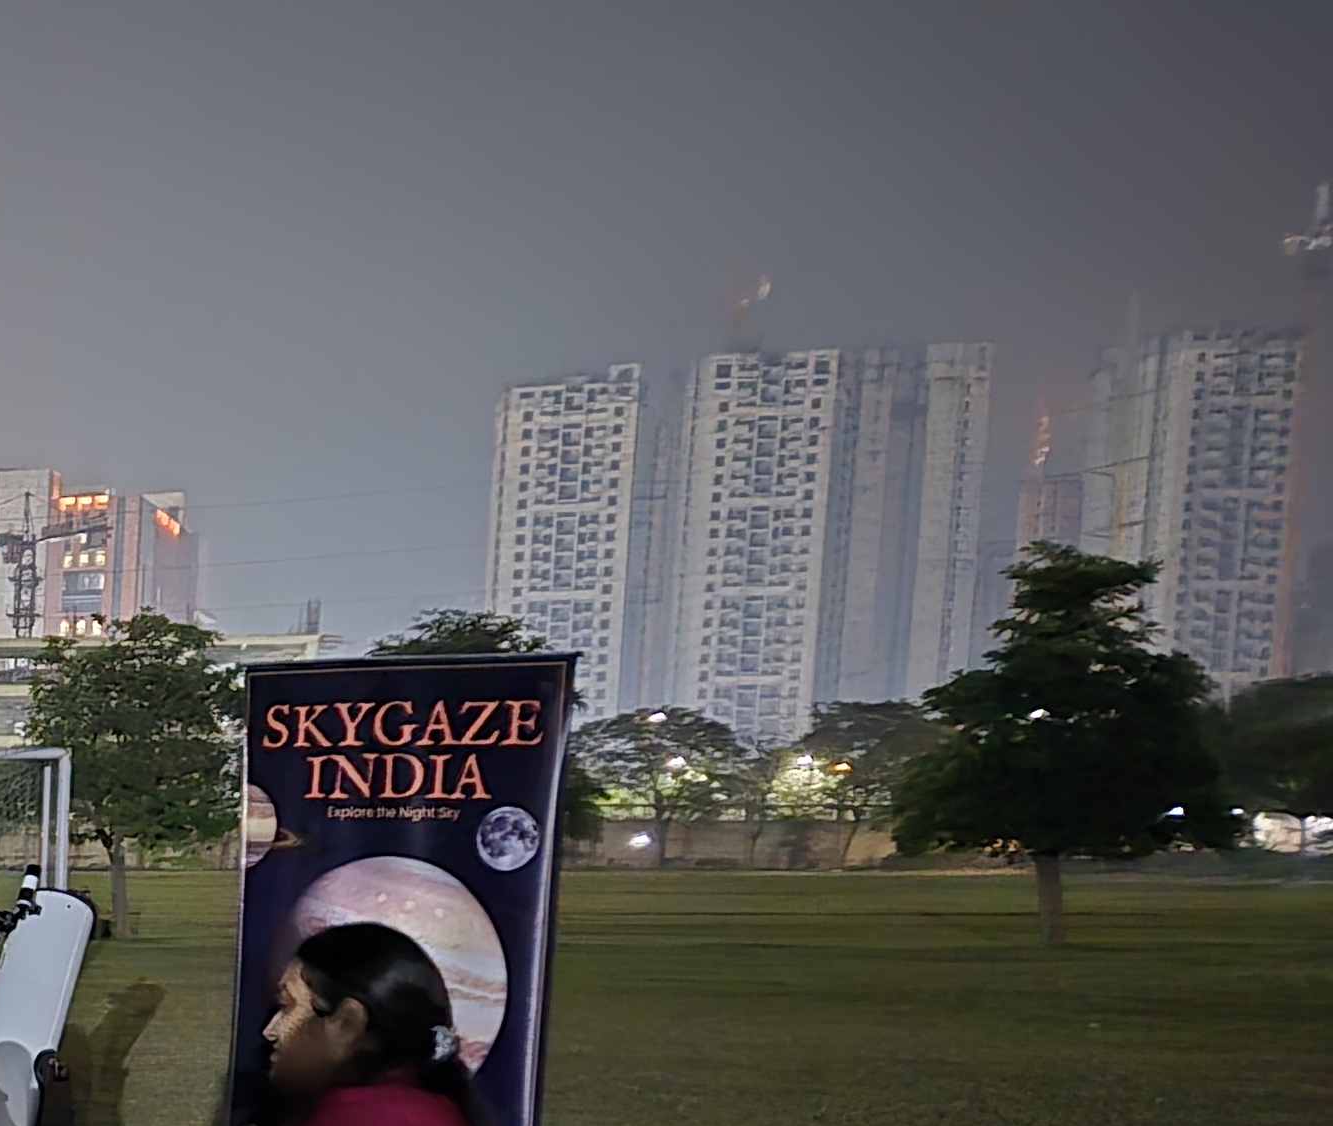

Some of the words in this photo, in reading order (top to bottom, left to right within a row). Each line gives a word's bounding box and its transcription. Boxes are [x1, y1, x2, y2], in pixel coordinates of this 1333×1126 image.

[262, 700, 544, 748] SKYGAZE
[303, 753, 493, 800] INDIA
[327, 805, 373, 821] Explore
[376, 806, 396, 818] the
[398, 805, 435, 822] Night
[437, 806, 461, 821] Sky
